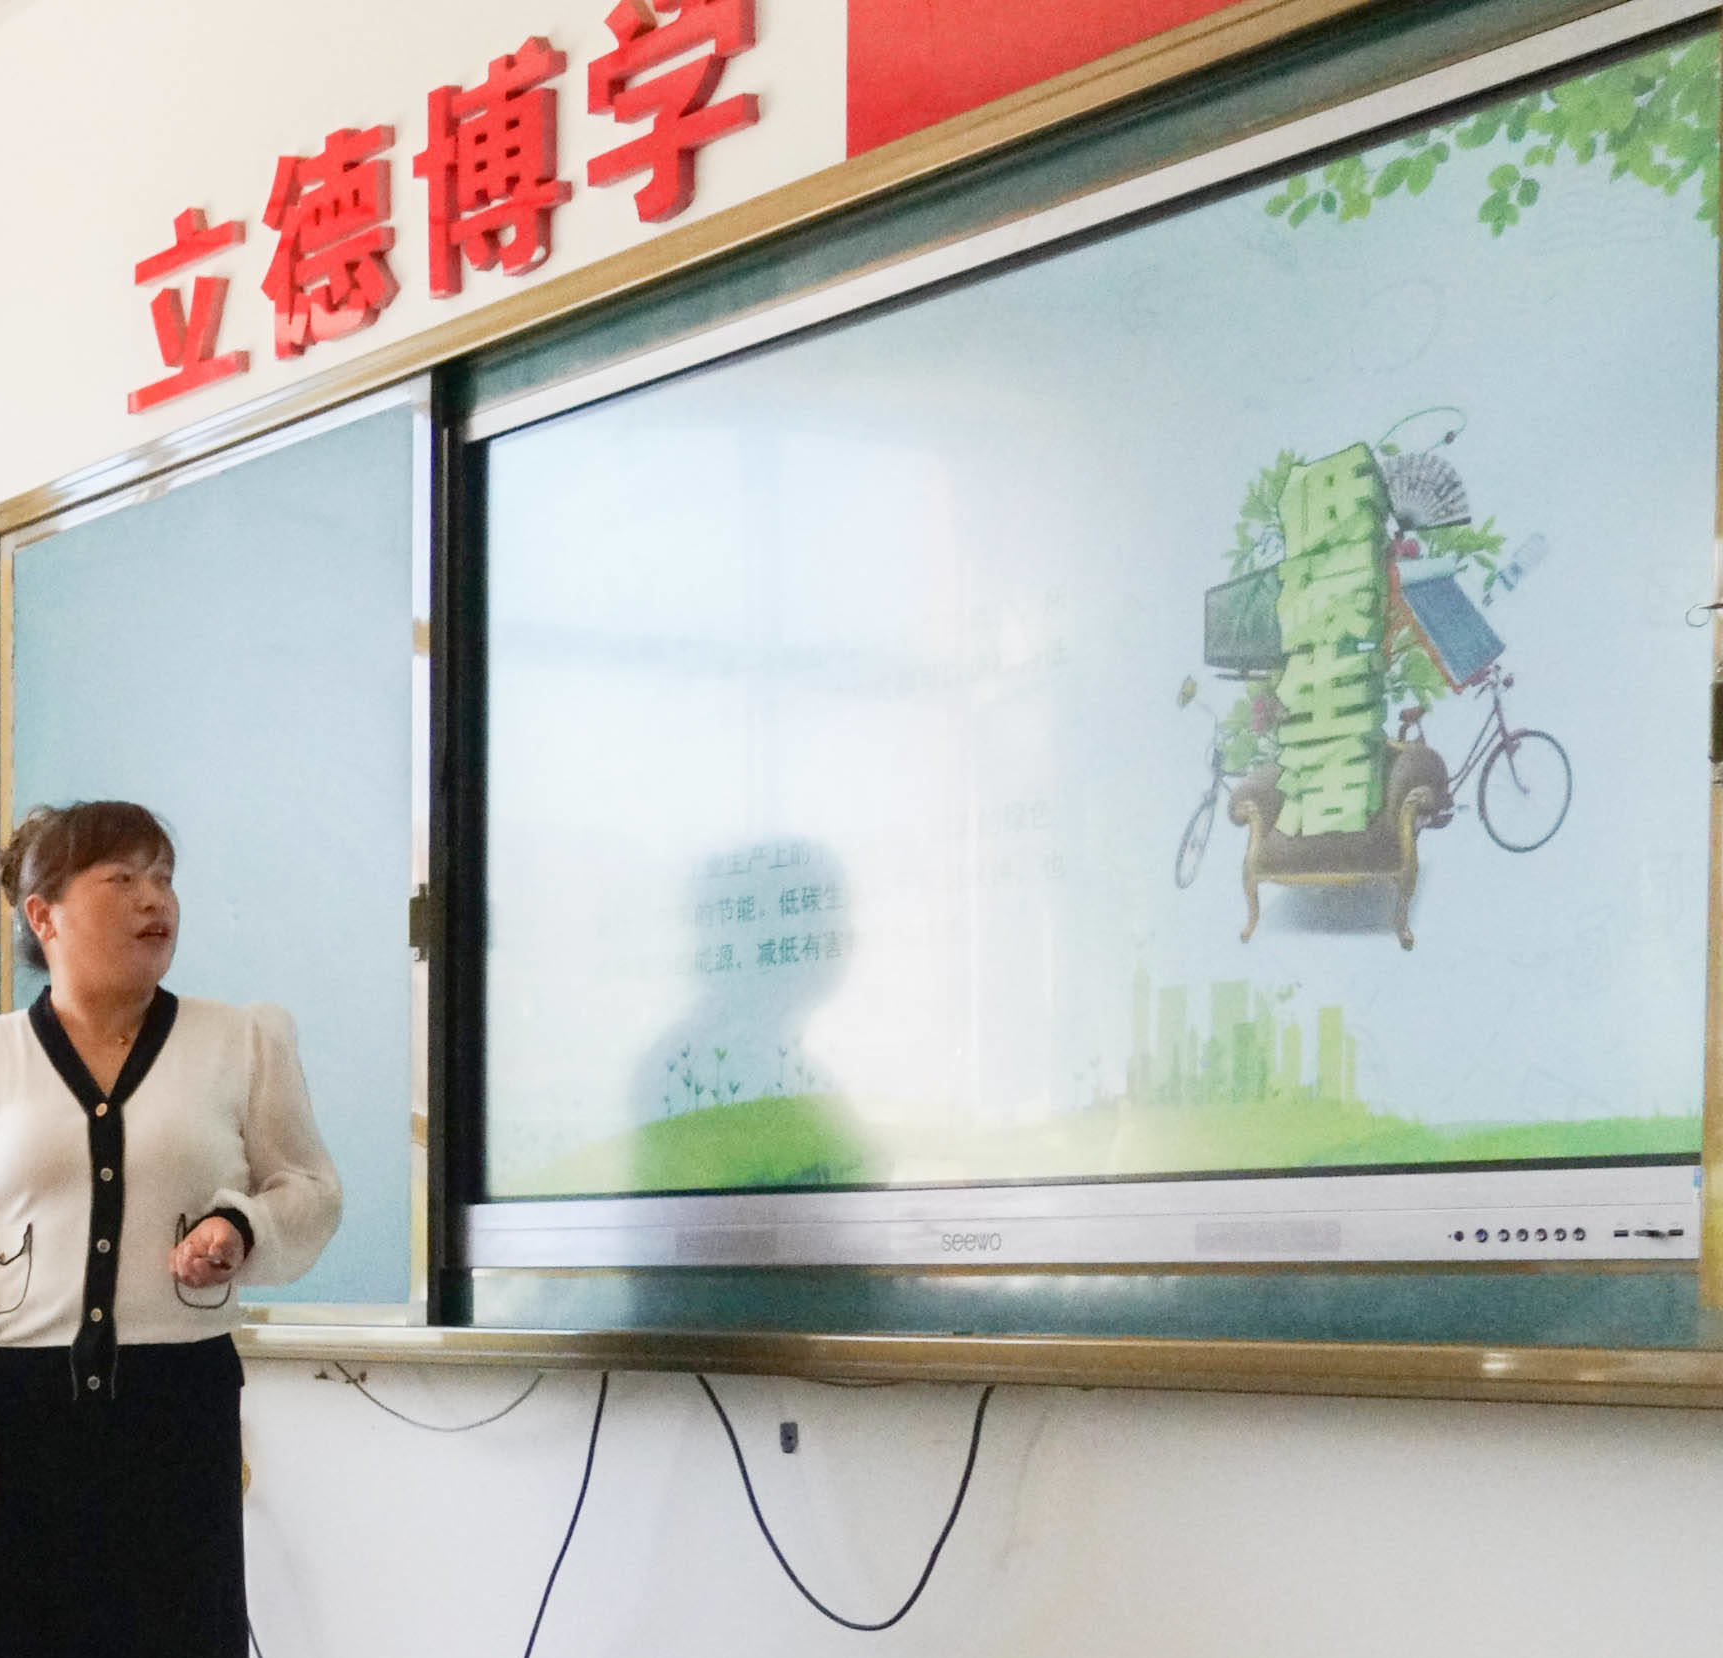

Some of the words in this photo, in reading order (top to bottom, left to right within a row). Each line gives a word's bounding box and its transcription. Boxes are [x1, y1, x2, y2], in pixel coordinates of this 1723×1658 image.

[128, 0, 760, 414] 立德博学
[941, 1232, 1003, 1252] seewo
